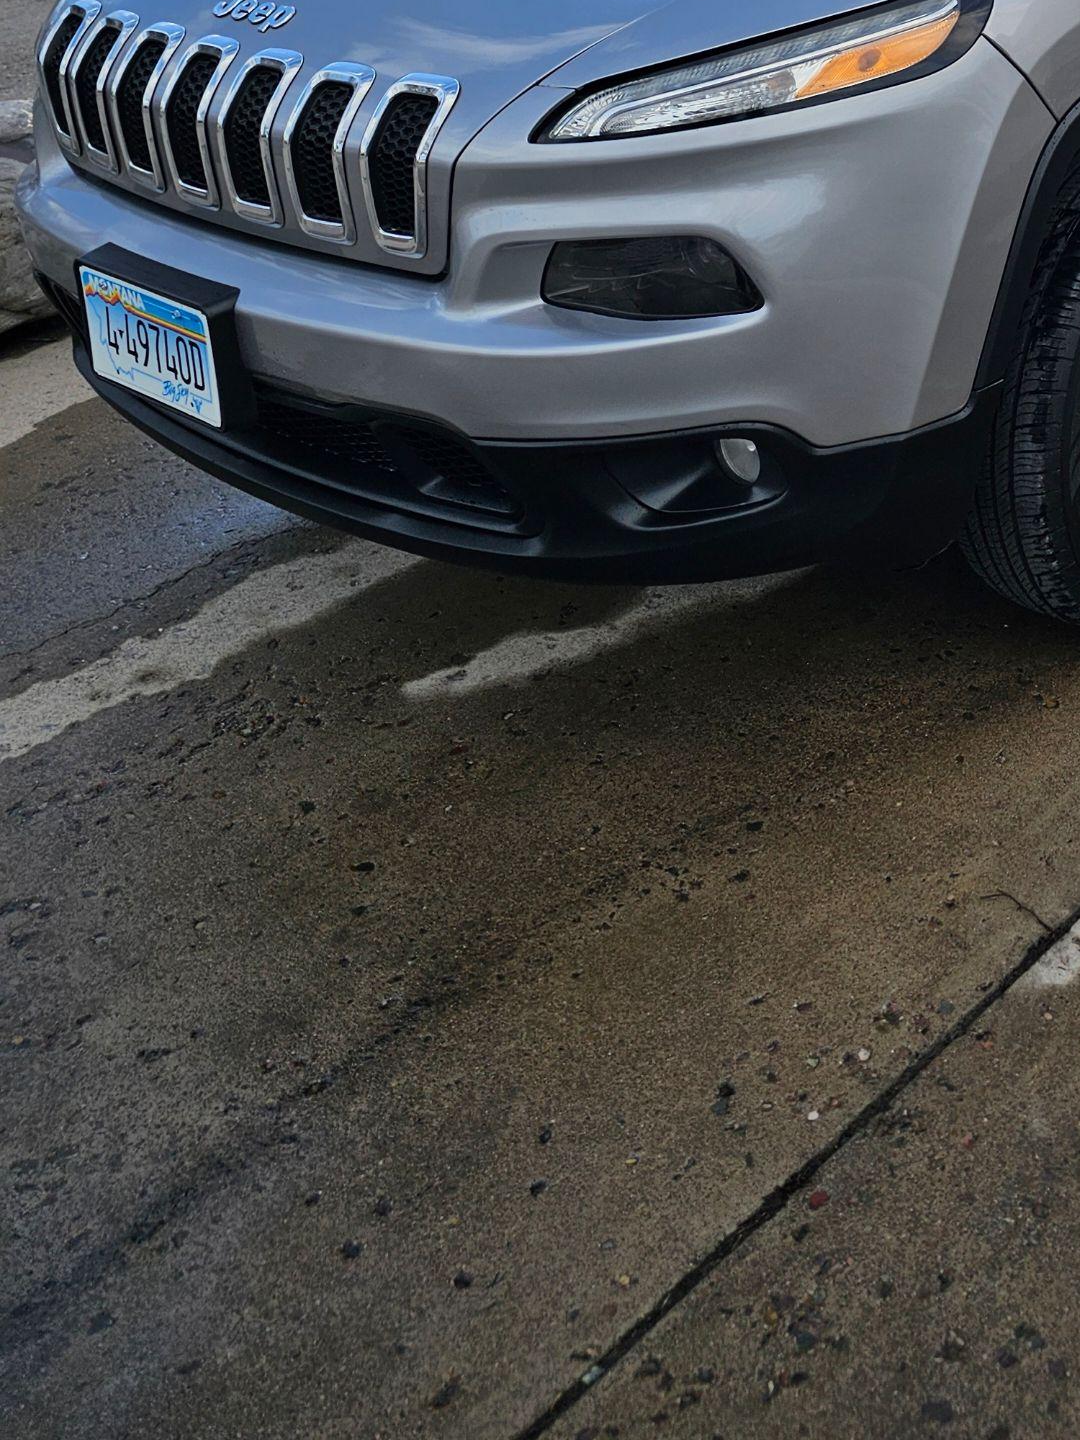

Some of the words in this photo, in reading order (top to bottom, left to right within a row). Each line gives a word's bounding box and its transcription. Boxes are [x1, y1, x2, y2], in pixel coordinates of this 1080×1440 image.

[88, 273, 146, 311] MONTANA
[162, 380, 176, 402] Big
[175, 383, 190, 405] Sky
